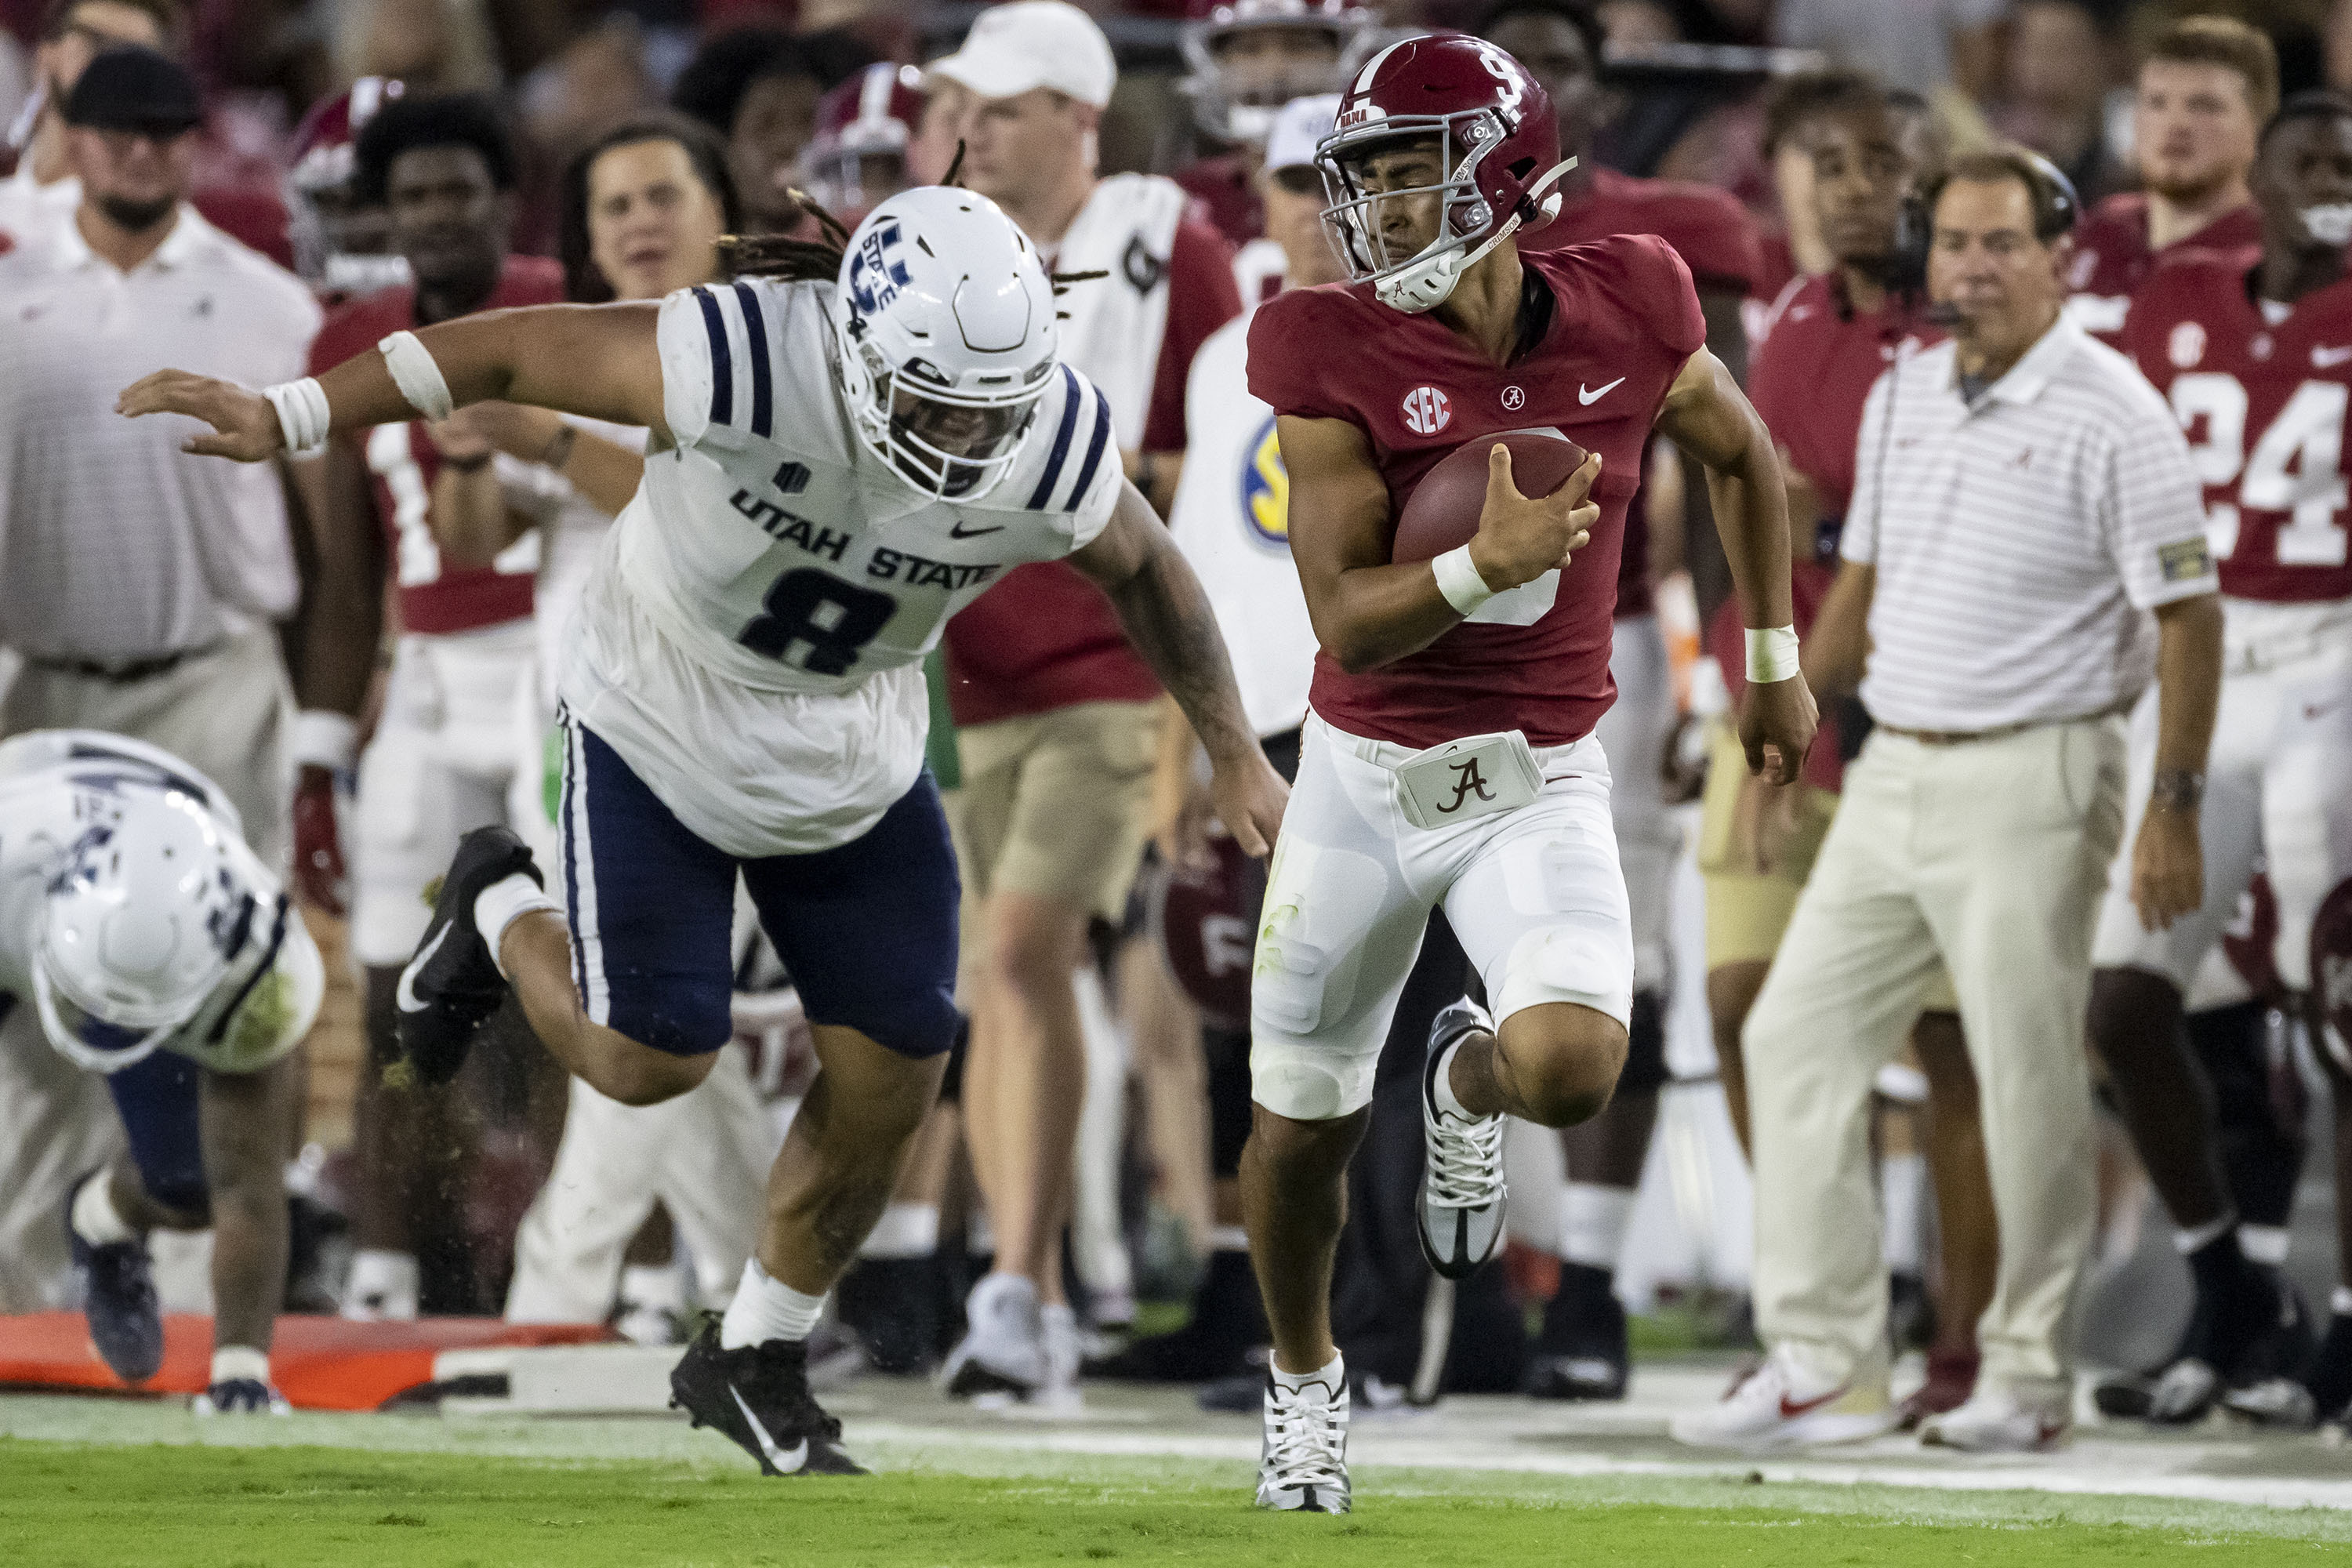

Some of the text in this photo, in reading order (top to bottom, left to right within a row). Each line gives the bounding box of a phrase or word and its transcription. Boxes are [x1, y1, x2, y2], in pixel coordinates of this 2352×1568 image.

[1479, 52, 1522, 105] 9
[1487, 216, 1519, 250] CRIMSON
[1403, 387, 1450, 434] SEC
[2171, 372, 2348, 567] 24
[729, 488, 852, 562] UTAH
[737, 566, 898, 677] 8
[1436, 757, 1497, 814] A
